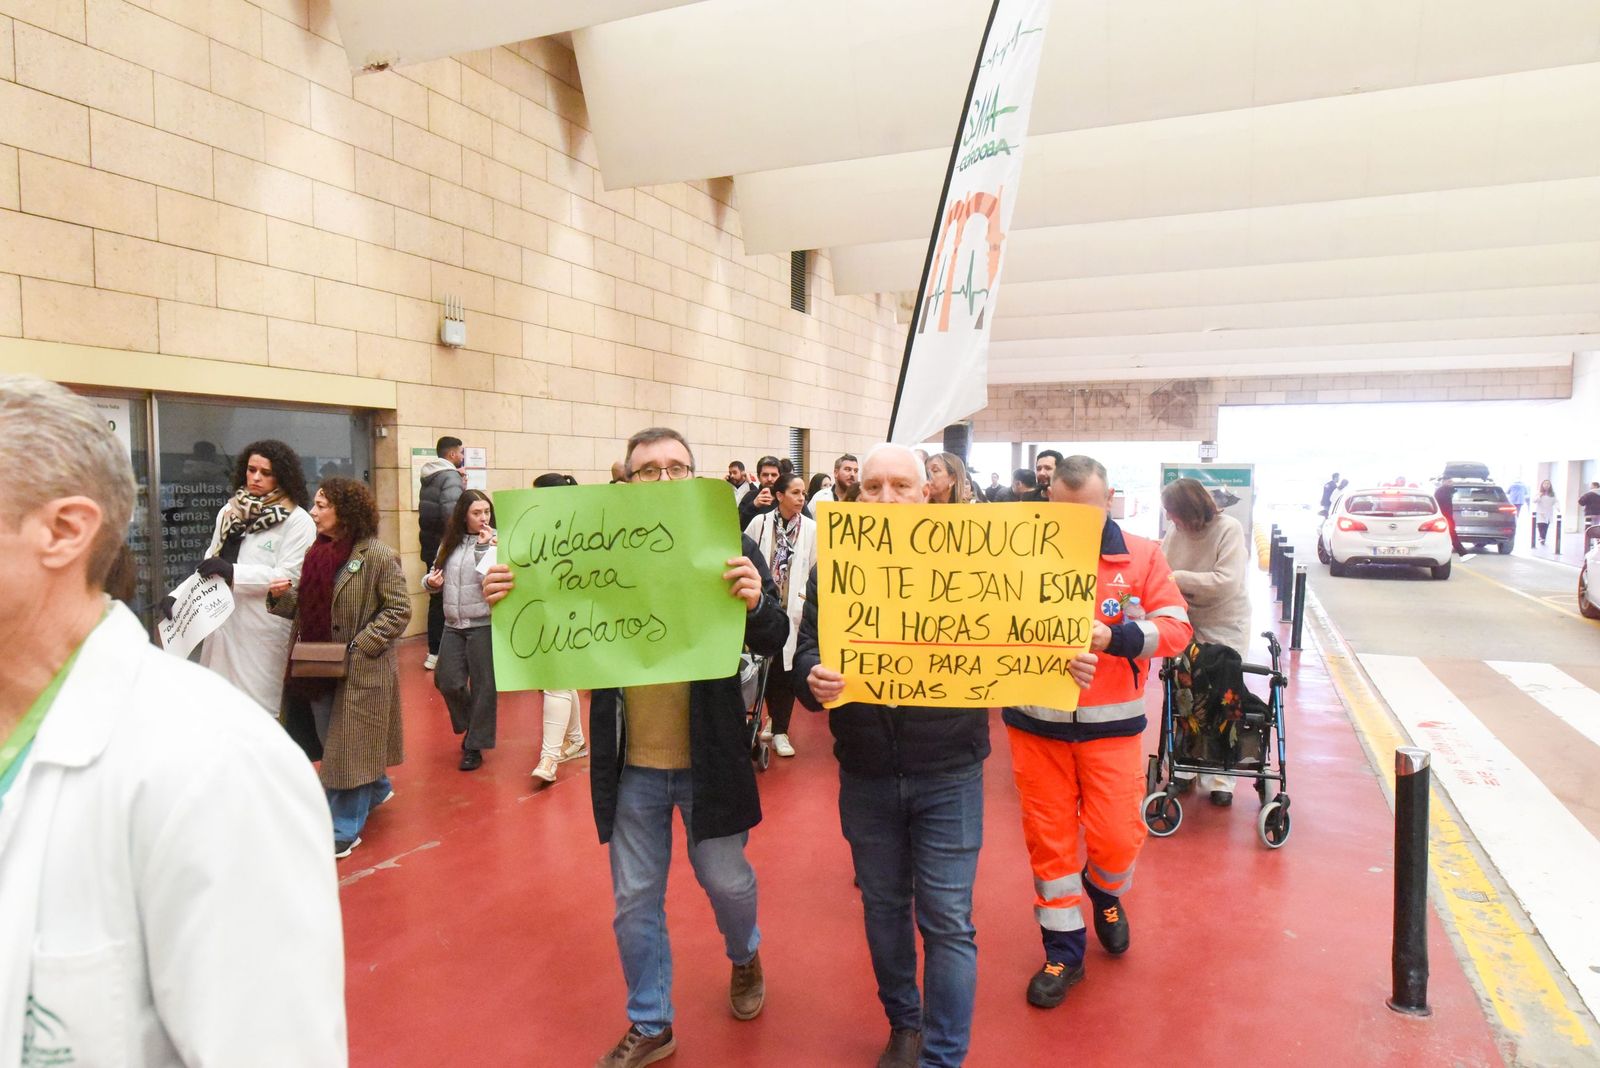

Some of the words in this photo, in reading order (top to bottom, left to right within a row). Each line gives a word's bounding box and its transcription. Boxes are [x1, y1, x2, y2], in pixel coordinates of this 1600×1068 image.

[828, 511, 893, 555] PARA
[201, 583, 218, 597] hay
[551, 559, 636, 591] Para
[830, 559, 866, 595] NO
[877, 566, 914, 599] TE
[930, 569, 1024, 603] DEJAN
[1039, 570, 1097, 604] ESTAR
[510, 599, 667, 659] Cuidaros
[845, 601, 880, 639] 24
[901, 612, 991, 642] HORAS
[1007, 615, 1091, 645] AGOTADO
[840, 648, 913, 676] PERO
[929, 653, 982, 676] PARA
